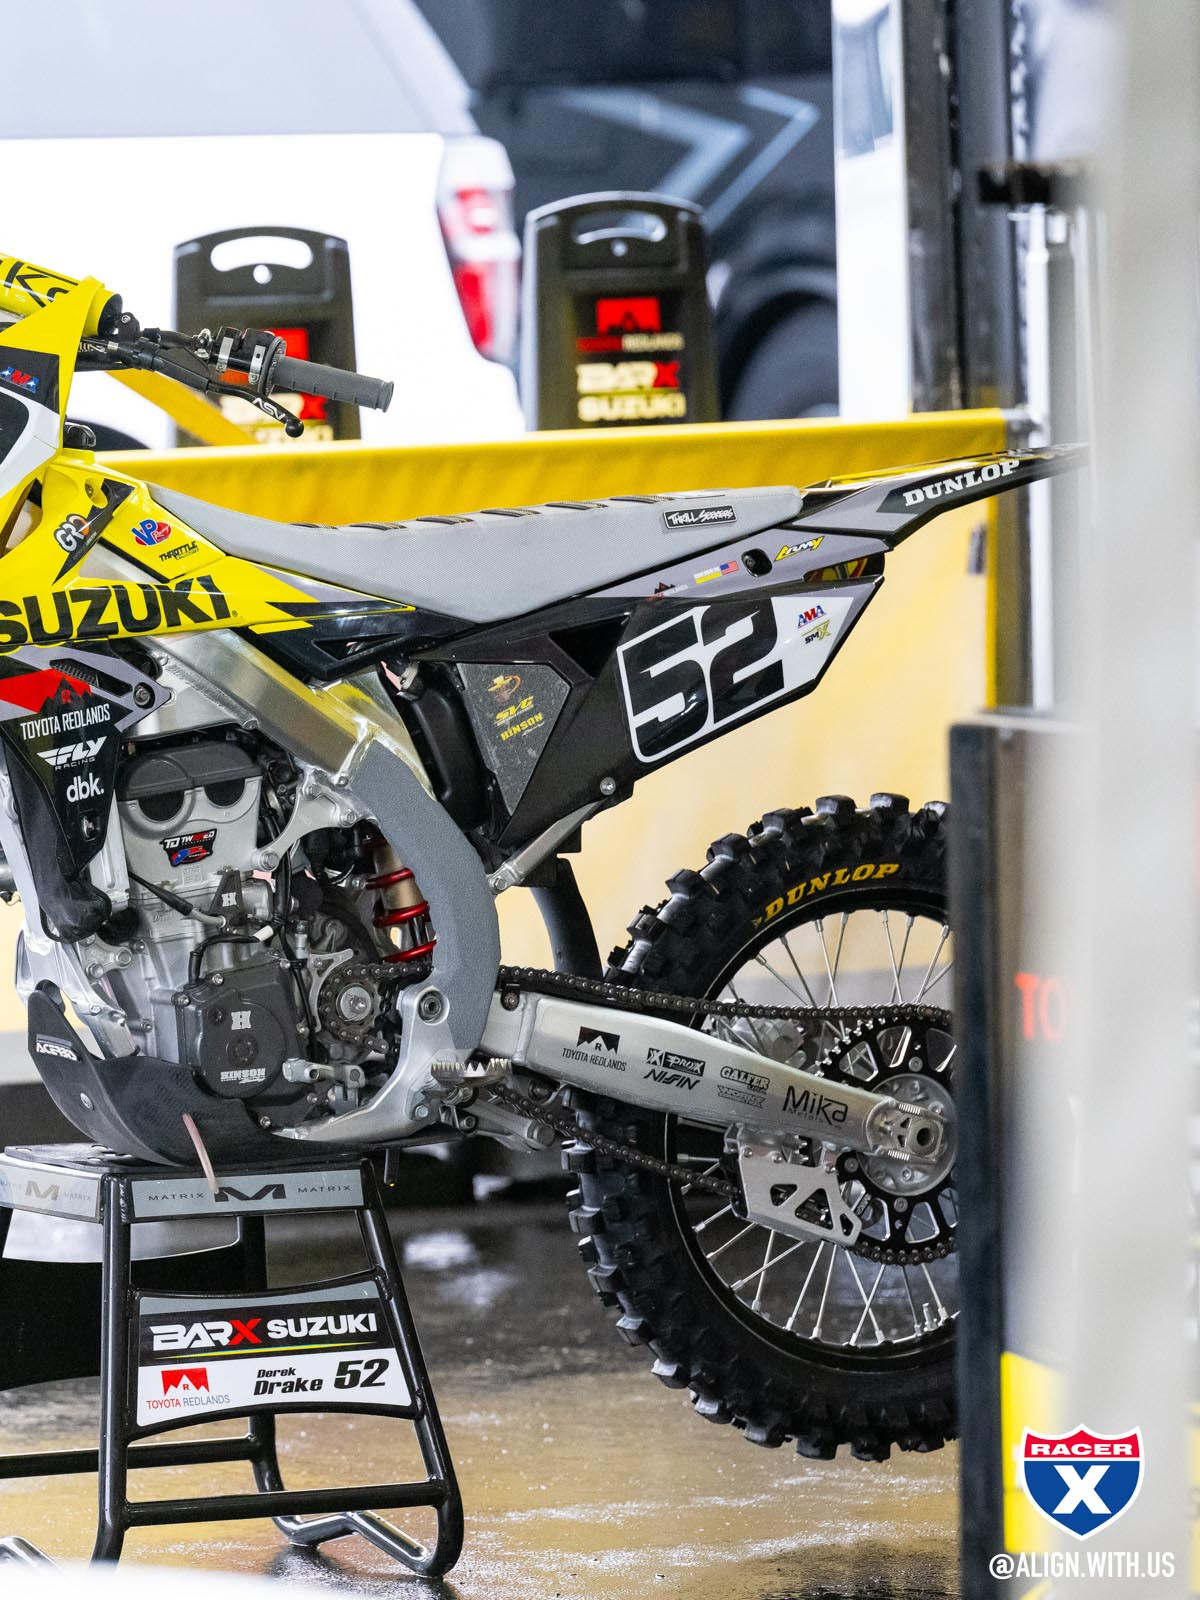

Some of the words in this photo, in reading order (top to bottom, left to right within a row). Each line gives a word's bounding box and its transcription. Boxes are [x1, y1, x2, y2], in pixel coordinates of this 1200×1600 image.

[252, 397, 286, 421] ASV
[902, 460, 1020, 507] DUNLOP
[131, 518, 158, 546] VP
[797, 604, 827, 629] AMA
[622, 599, 785, 758] 52
[20, 715, 61, 741] TOYOTA
[62, 703, 111, 732] REDLANDS
[37, 736, 107, 767] FLY
[55, 756, 96, 772] RACING
[764, 863, 899, 923] DUNLOP
[562, 1047, 589, 1062] TOYOTA
[589, 1054, 627, 1072] REDLANDS
[721, 1066, 769, 1090] GALFER
[782, 1085, 849, 1126] Mika
[148, 1192, 205, 1201] MATRIX
[297, 1184, 352, 1194] MATRIX
[149, 1317, 263, 1352] BARX
[266, 1312, 378, 1339] SUZUKI
[256, 1366, 296, 1379] Derek
[333, 1358, 390, 1391] 52
[182, 1383, 190, 1391] R
[253, 1376, 324, 1397] Drake
[146, 1398, 181, 1410] TOYOTA
[182, 1394, 231, 1408] REDLANDS
